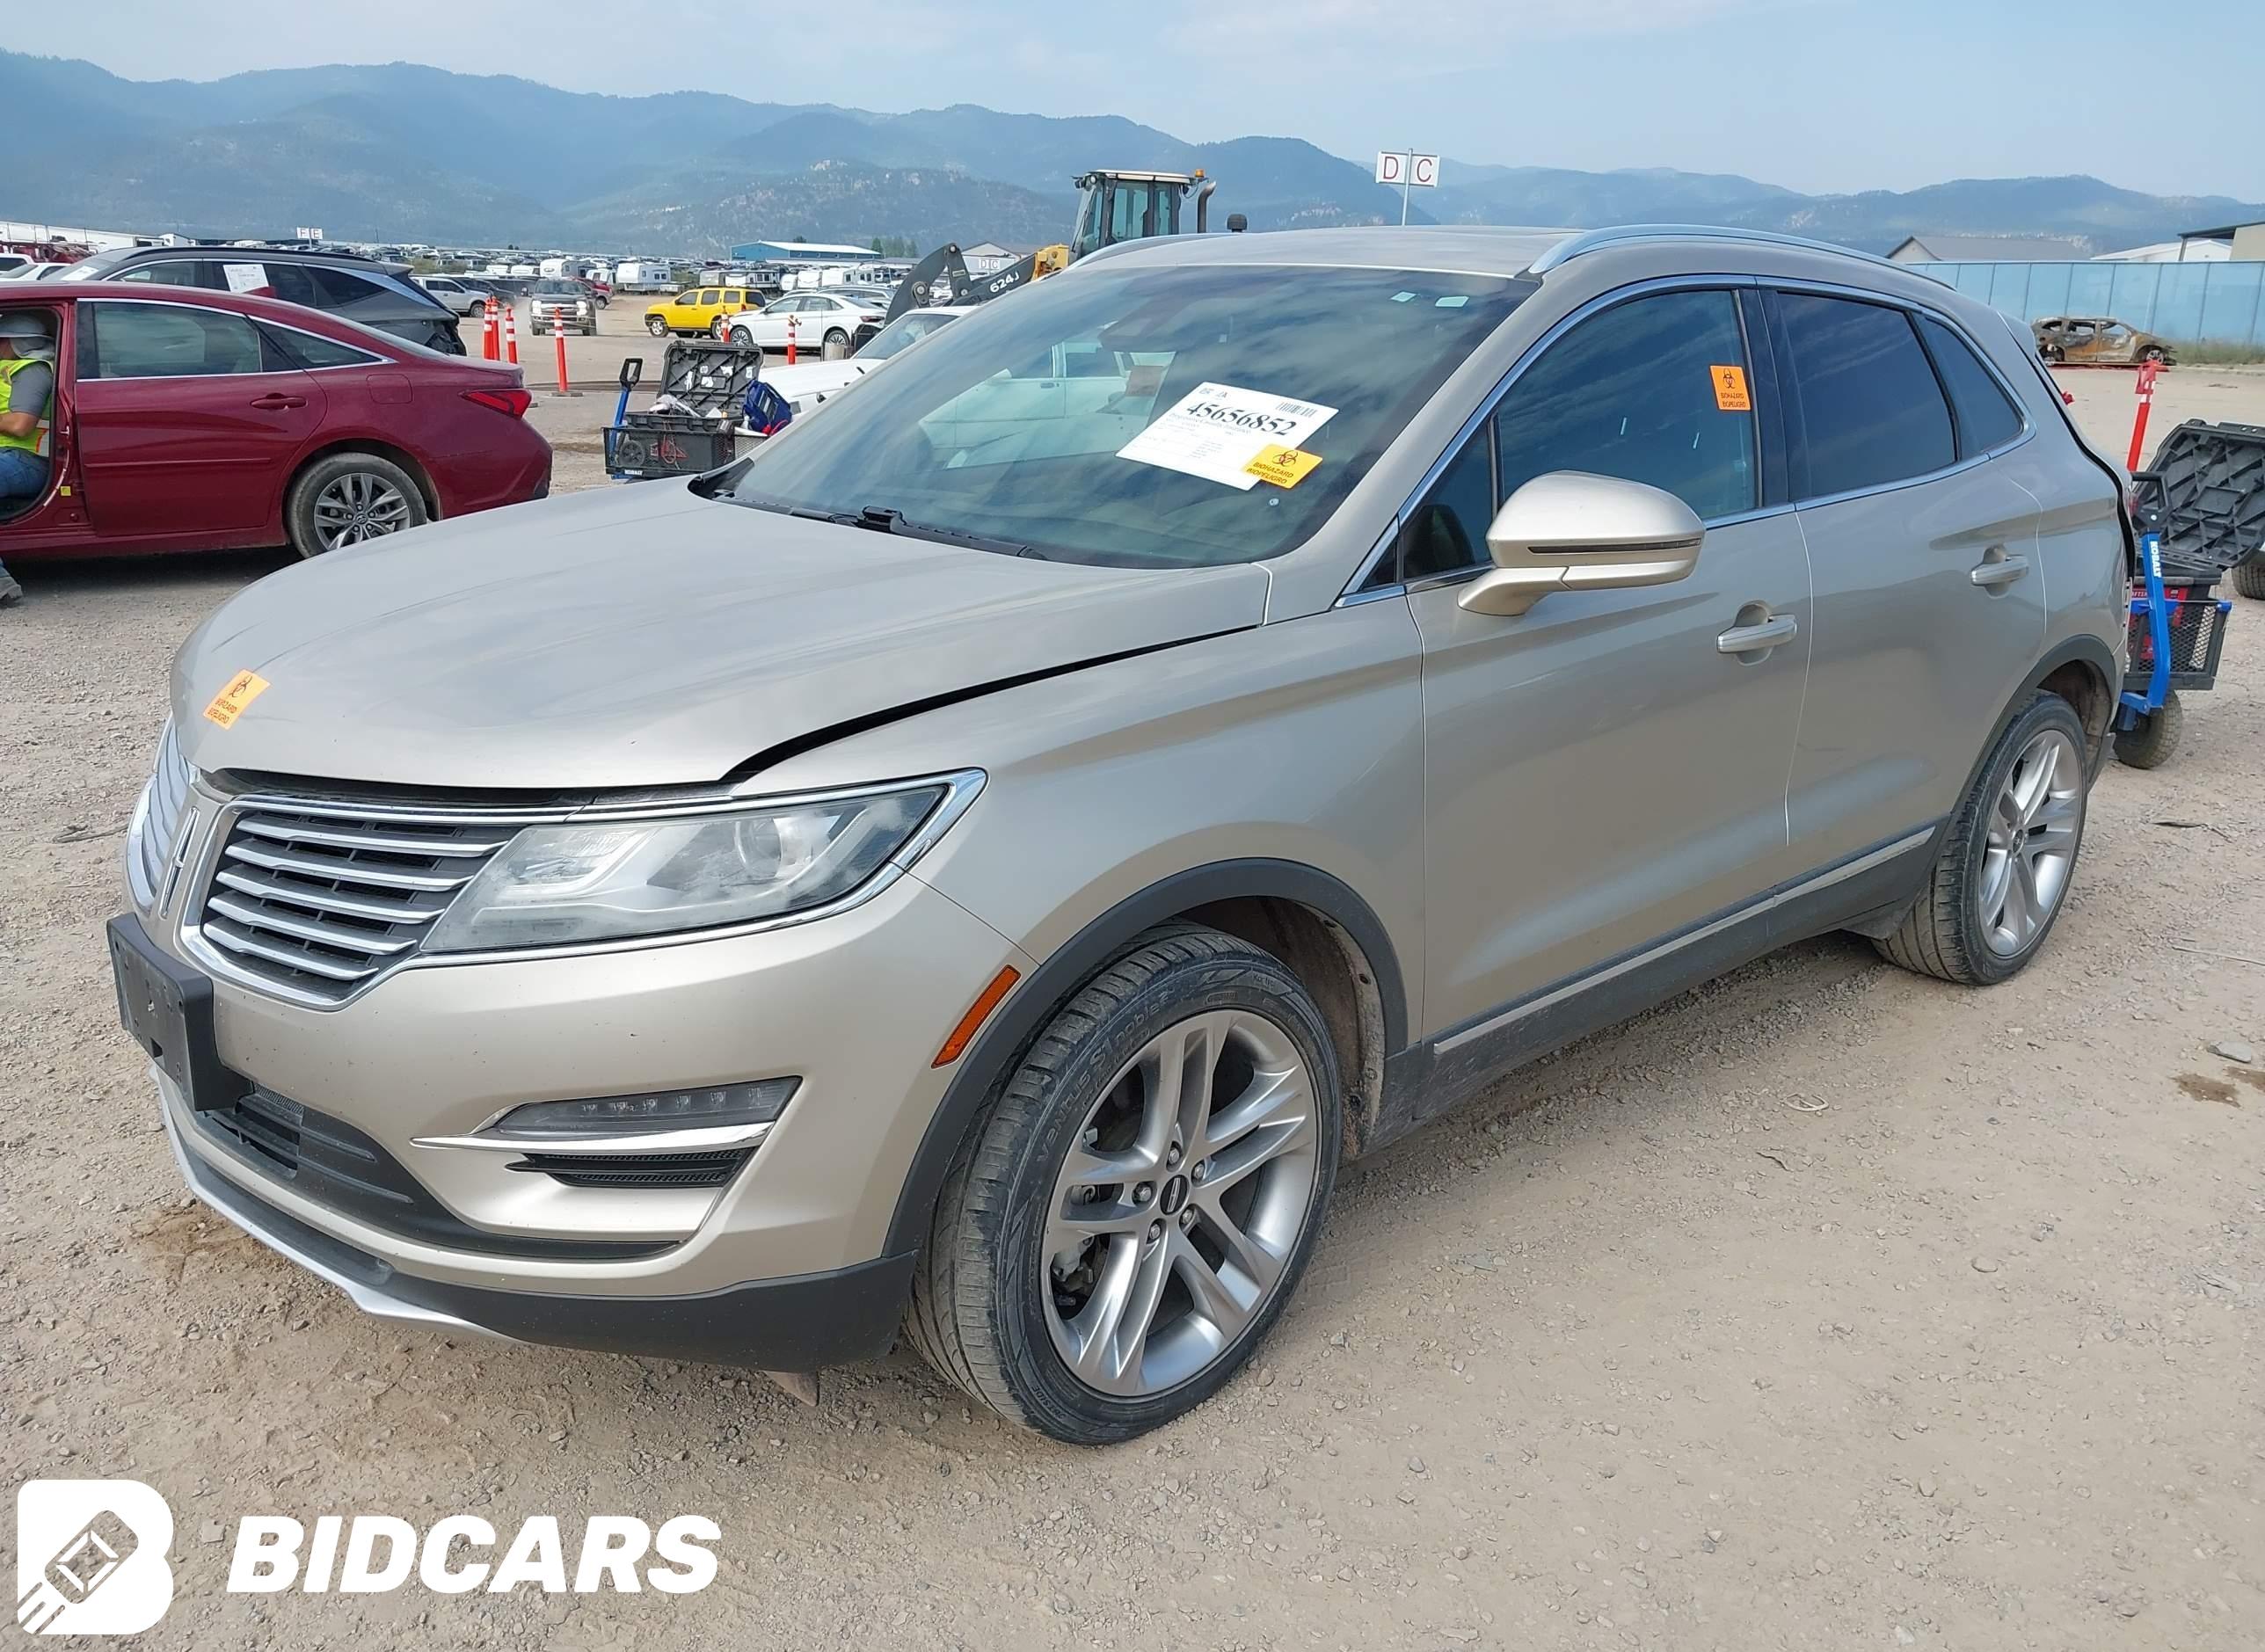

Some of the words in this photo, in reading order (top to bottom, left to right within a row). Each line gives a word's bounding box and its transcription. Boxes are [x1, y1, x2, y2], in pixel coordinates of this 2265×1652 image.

[1383, 156, 1399, 179] D
[1417, 158, 1432, 183] C
[989, 271, 1020, 293] 624J
[1186, 401, 1298, 437] 45656852
[1246, 468, 1288, 484] BIOPELIGRO
[1253, 462, 1294, 478] BIOHAZARD
[2150, 541, 2162, 578] KOBALT
